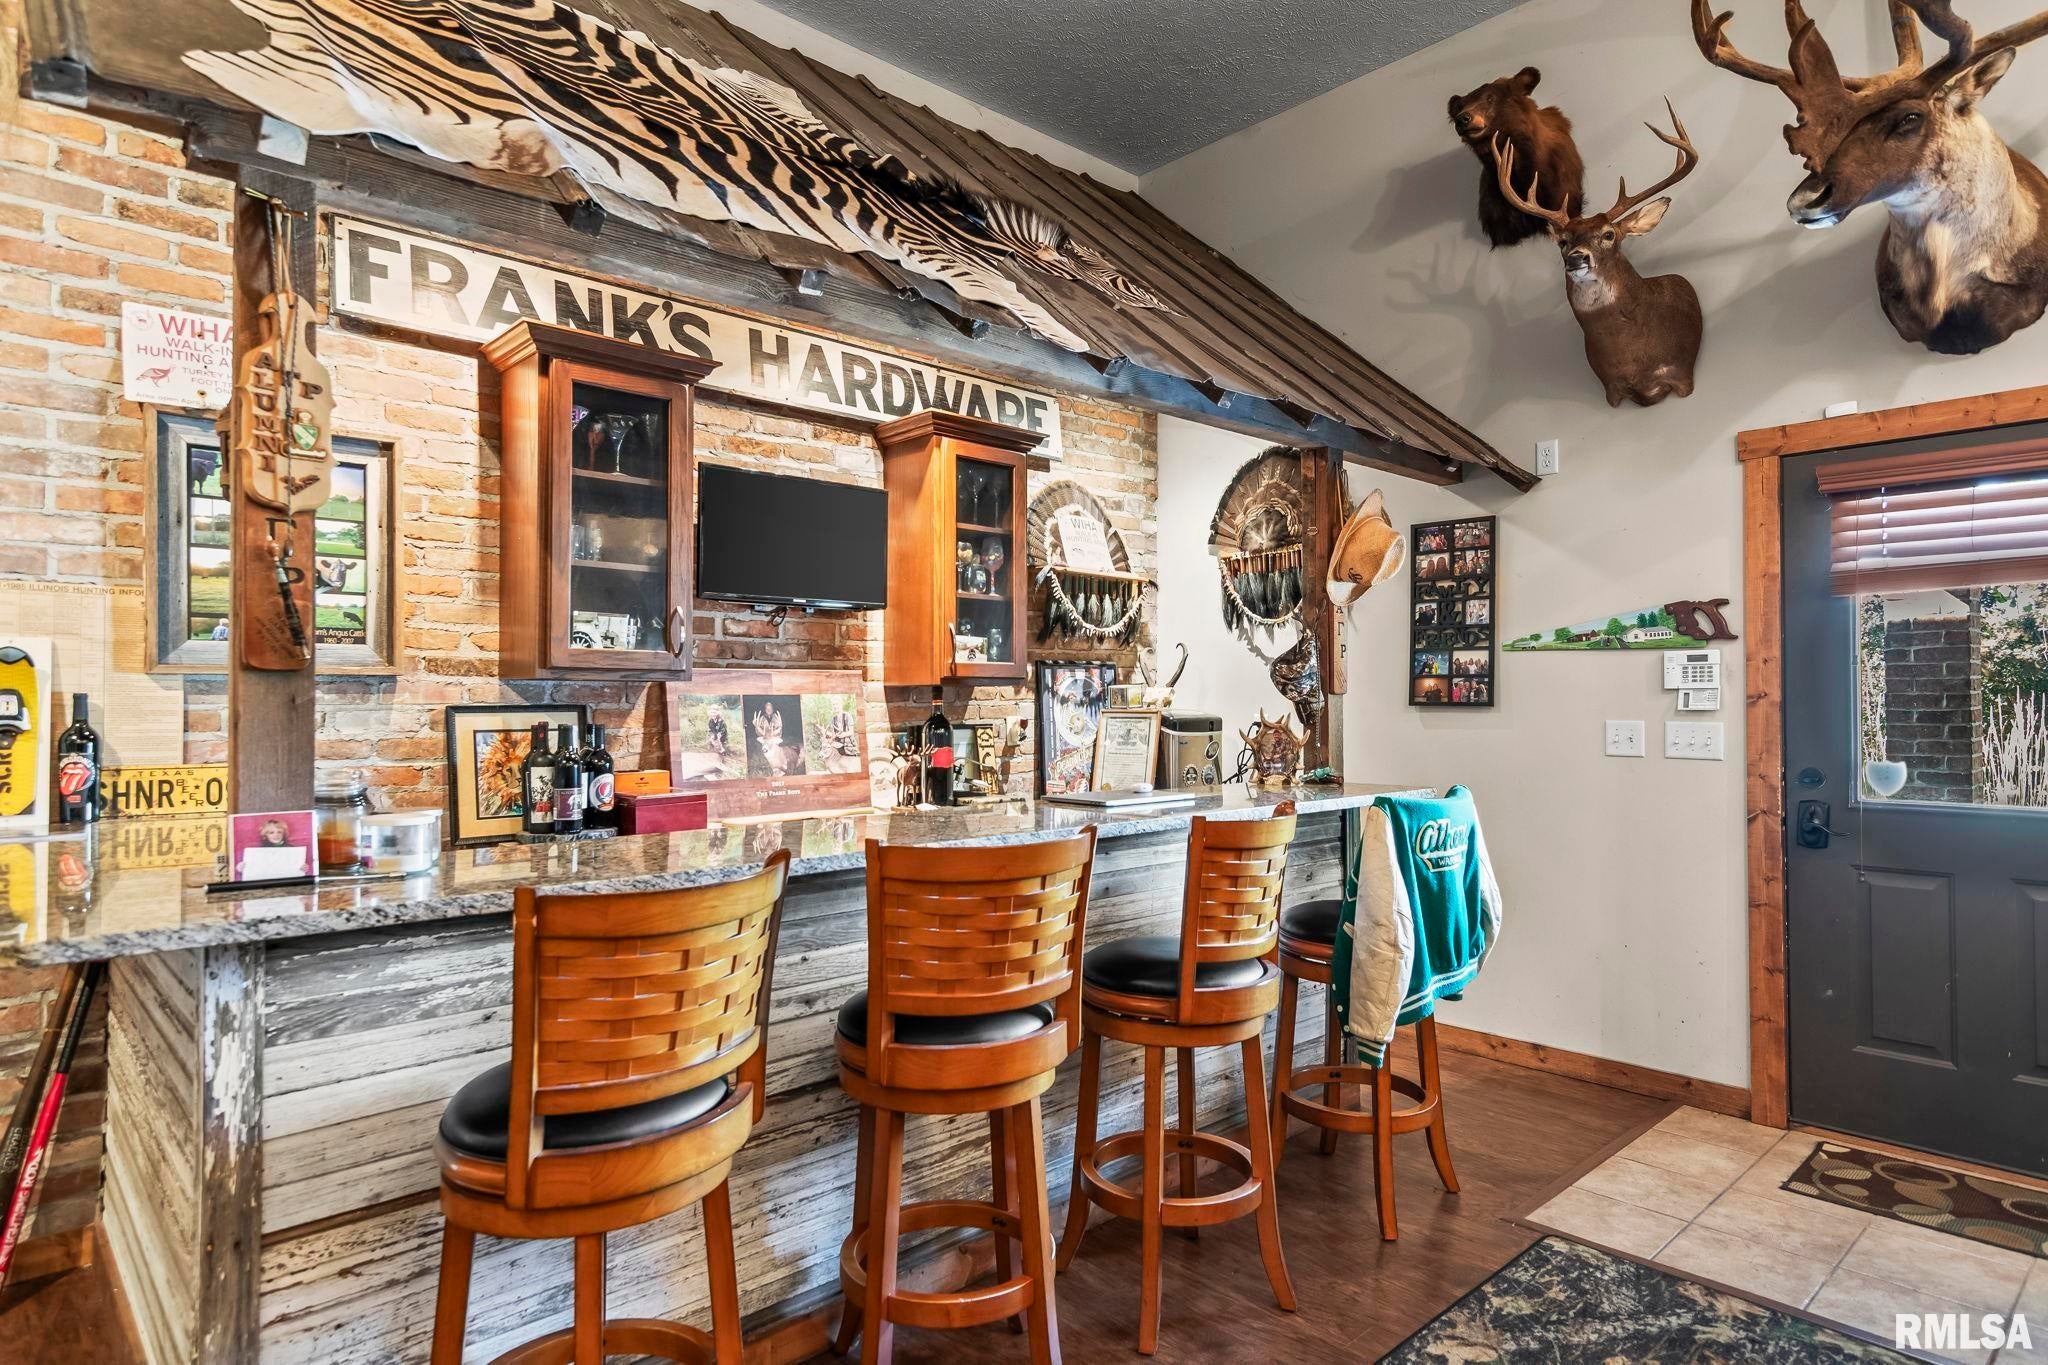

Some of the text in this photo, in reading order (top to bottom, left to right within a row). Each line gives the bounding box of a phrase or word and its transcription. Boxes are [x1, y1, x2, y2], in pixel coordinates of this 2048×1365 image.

[348, 228, 711, 358] FRANK'S
[137, 344, 214, 365] HUNTING
[29, 583, 69, 592] ILLINOIS
[73, 586, 115, 596] HUNTING
[138, 769, 194, 777] TEXAS
